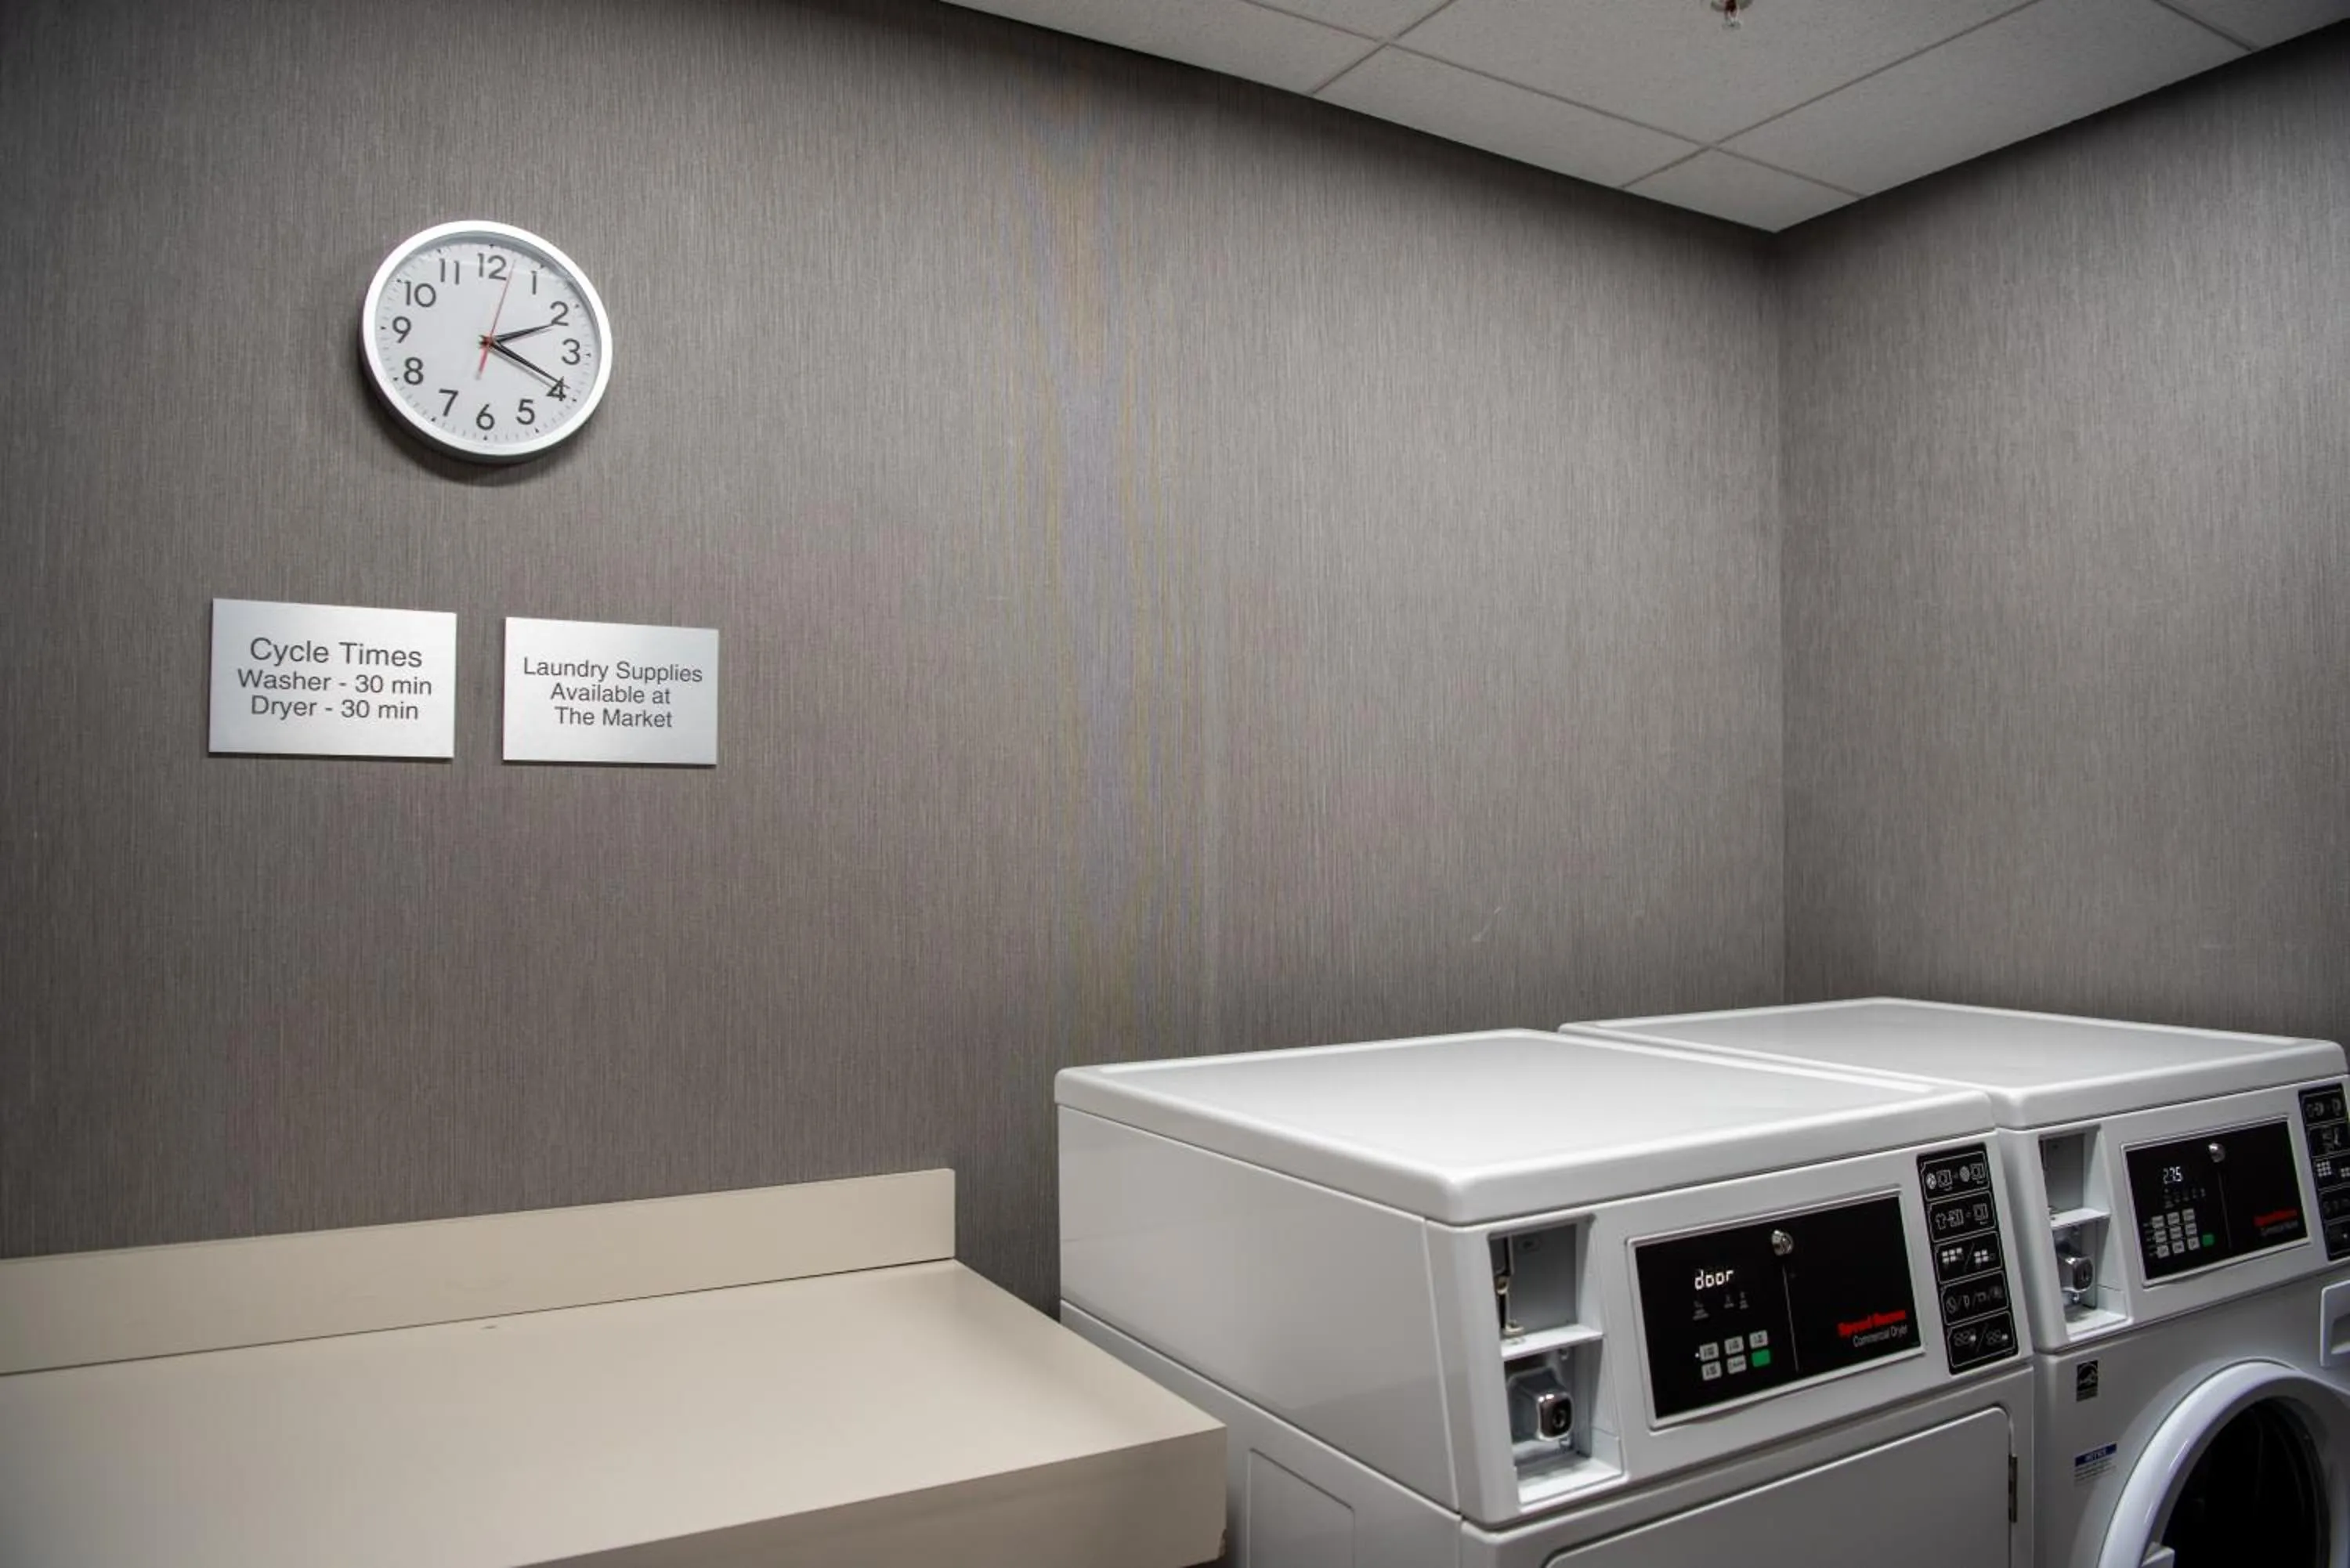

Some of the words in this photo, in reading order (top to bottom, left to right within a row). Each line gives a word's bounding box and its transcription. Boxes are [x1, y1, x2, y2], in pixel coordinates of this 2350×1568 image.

[439, 258, 460, 285] 11
[478, 253, 507, 281] 12
[405, 280, 436, 308] 10
[530, 270, 537, 295] 1
[550, 301, 569, 326] 2
[392, 316, 411, 343] 9
[562, 338, 580, 365] 3
[403, 357, 424, 385] 8
[546, 376, 566, 401] 4
[439, 388, 459, 417] 7
[516, 399, 535, 425] 5
[476, 404, 495, 430] 6
[250, 637, 329, 667] Cycle
[338, 641, 422, 667] Times
[237, 668, 331, 691] Washer
[355, 674, 383, 693] 30
[392, 677, 432, 695] min
[523, 657, 609, 682] Laundry
[616, 660, 703, 685] Supplies
[251, 695, 317, 720] Dryer
[341, 699, 370, 718] 30
[378, 702, 418, 720] min
[550, 683, 645, 704] Available
[652, 689, 671, 705] at
[555, 706, 595, 726] The
[602, 708, 672, 728] Market
[1694, 1269, 1734, 1291] door
